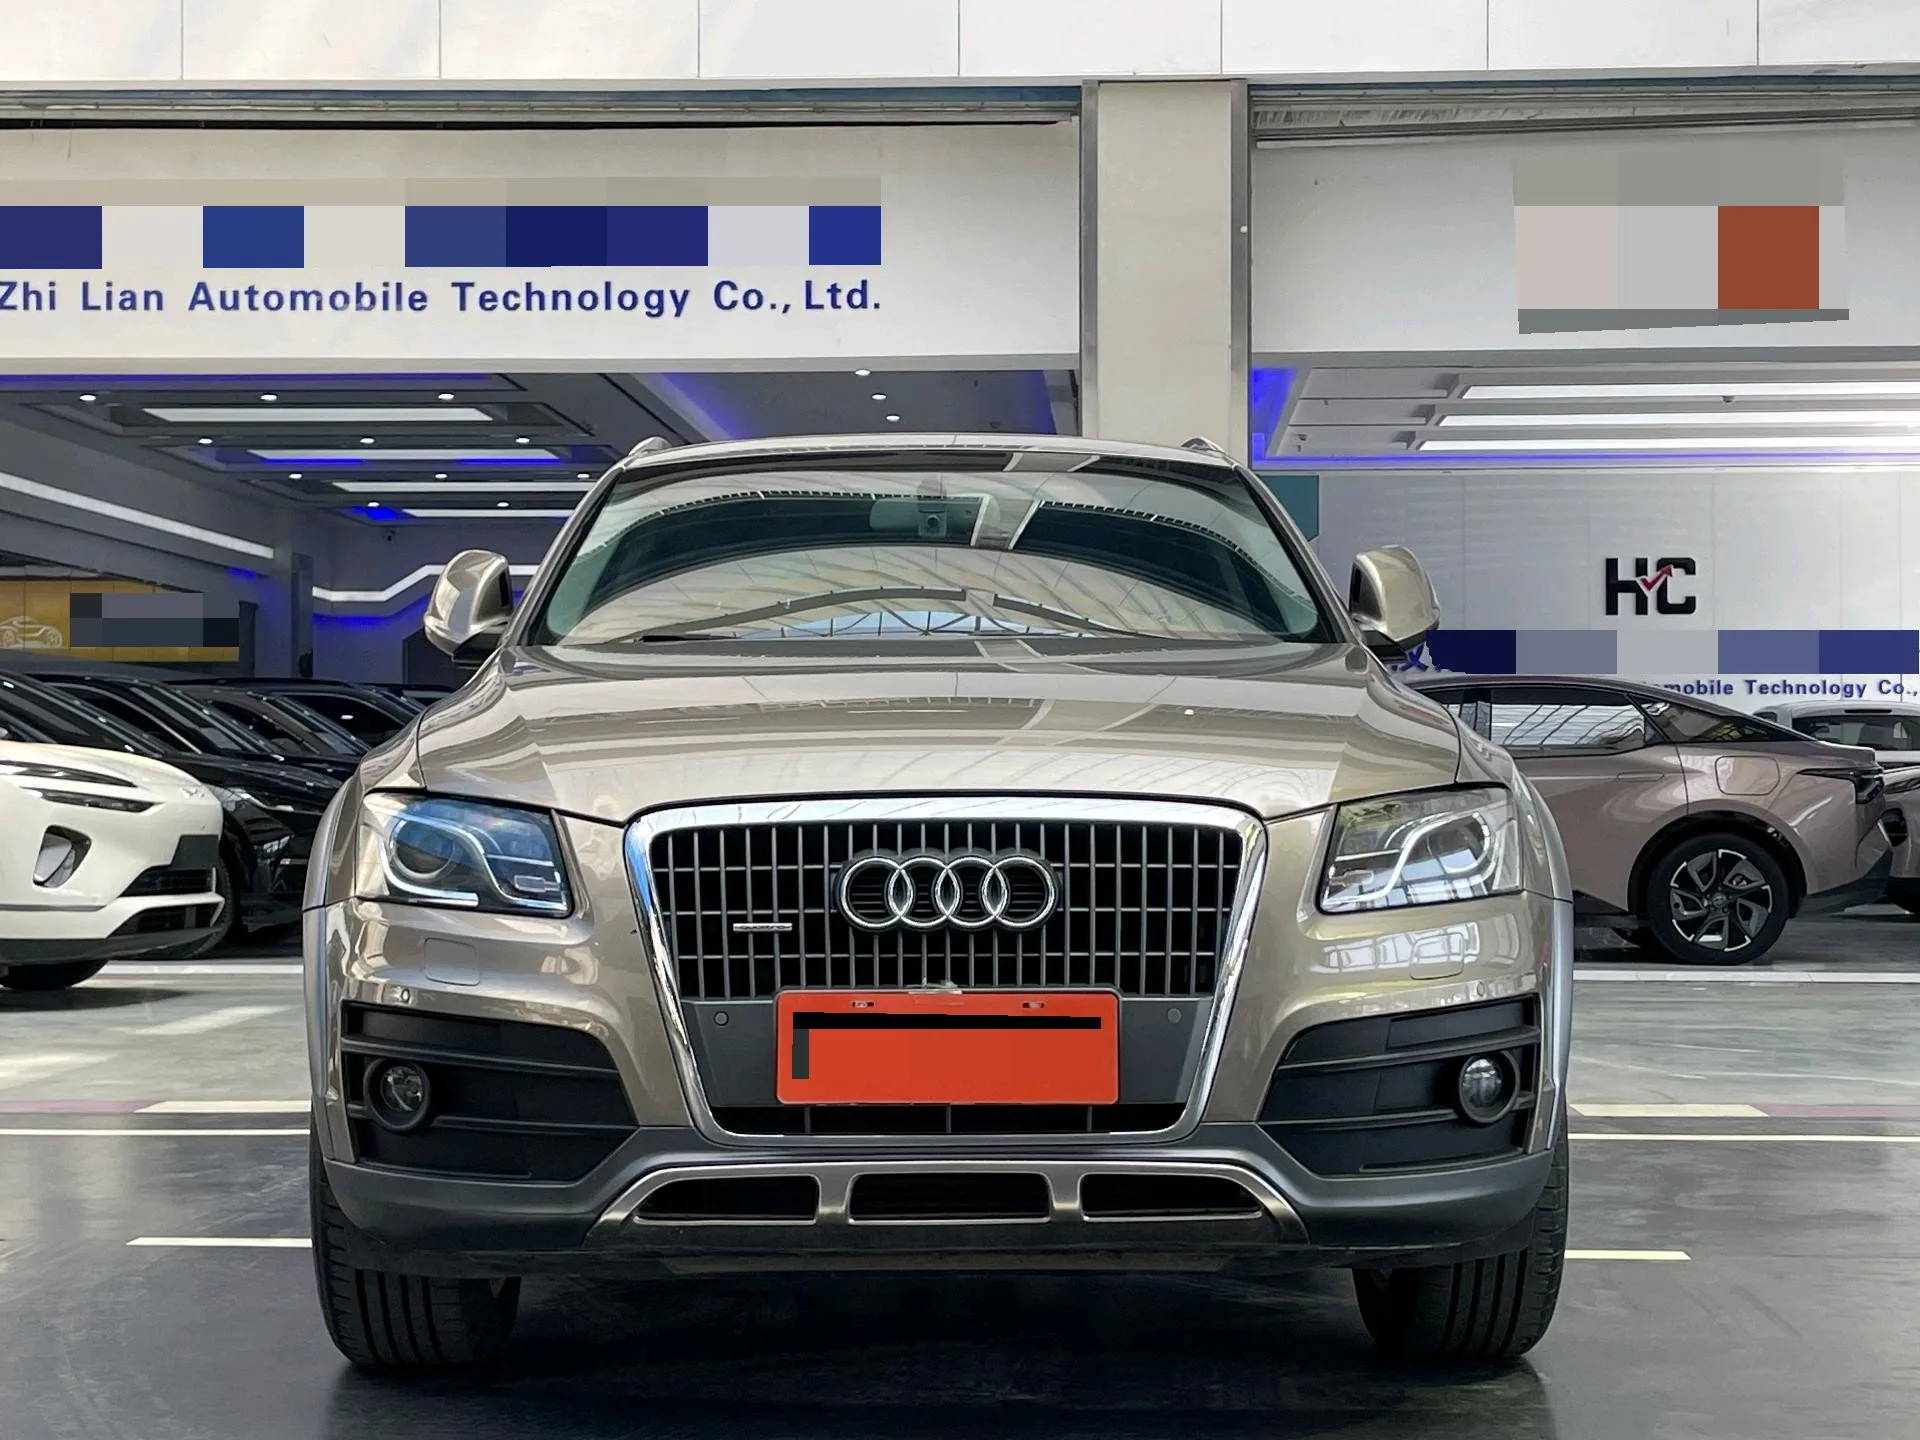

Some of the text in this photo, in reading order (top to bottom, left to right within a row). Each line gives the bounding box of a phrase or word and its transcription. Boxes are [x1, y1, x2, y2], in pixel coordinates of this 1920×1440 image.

[0, 279, 881, 318] Zhi Lian Automobile Technology Co., Ltd.
[1743, 679, 1867, 698] Technology
